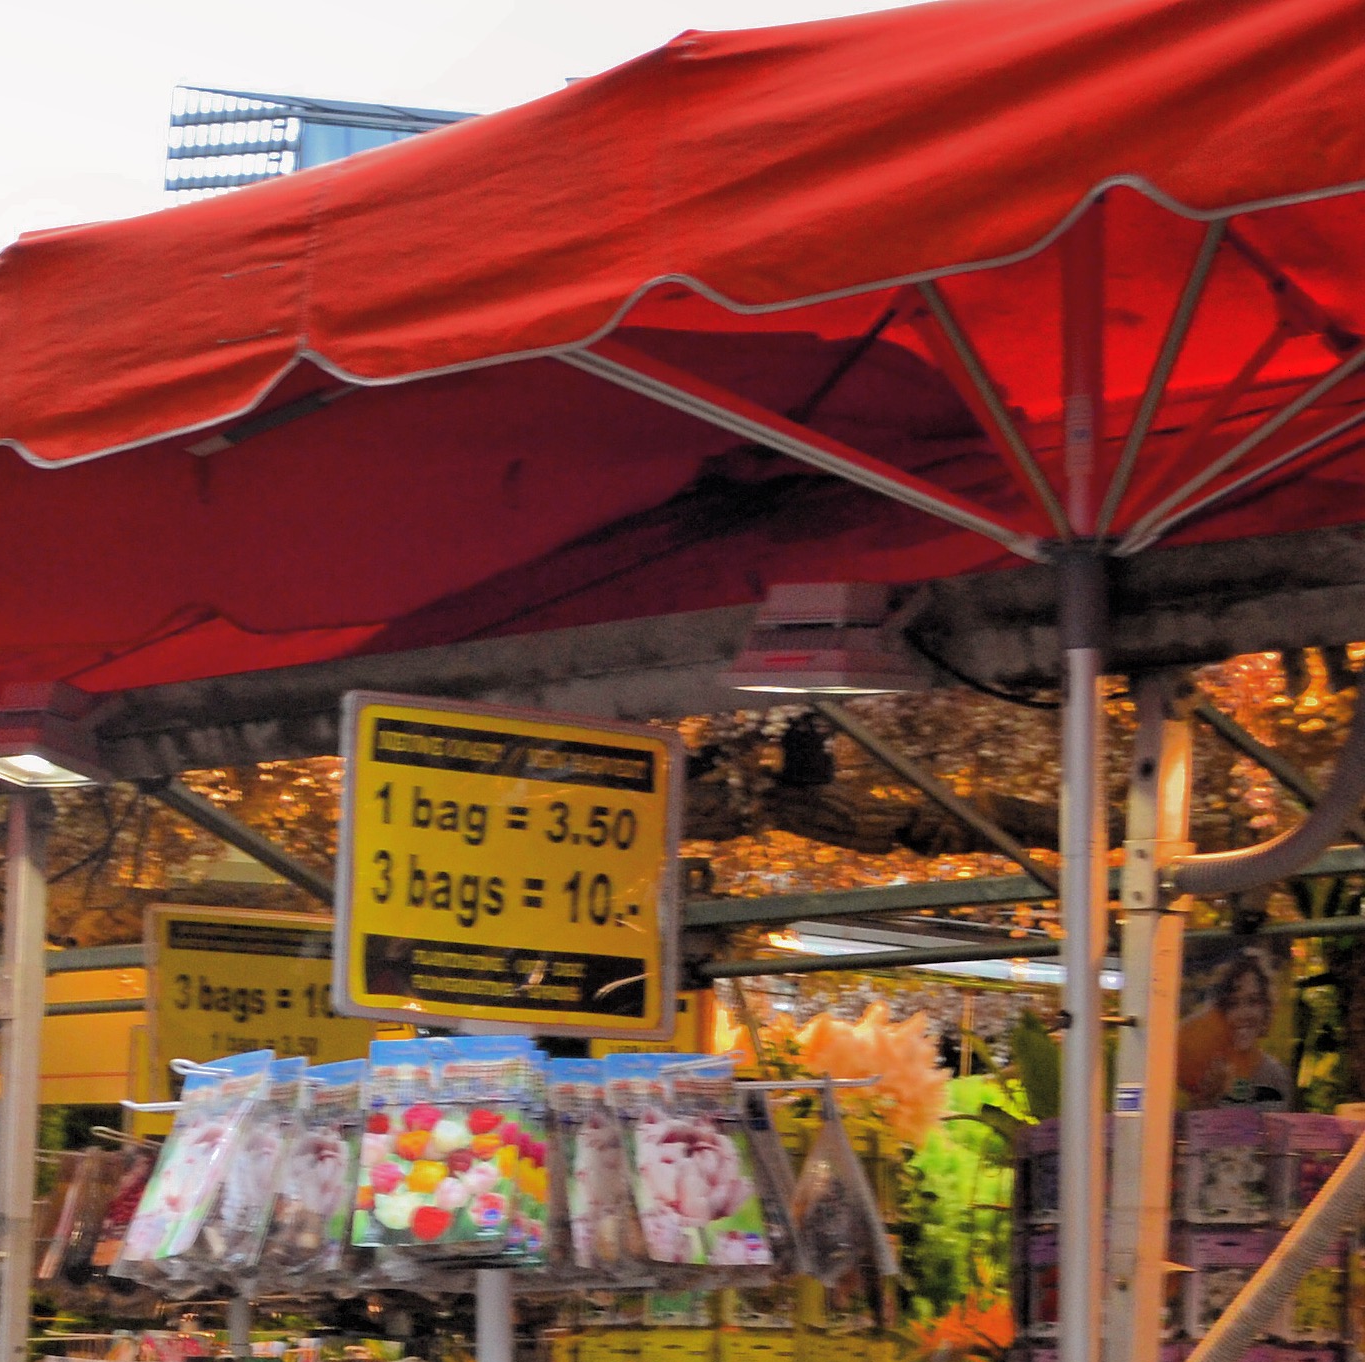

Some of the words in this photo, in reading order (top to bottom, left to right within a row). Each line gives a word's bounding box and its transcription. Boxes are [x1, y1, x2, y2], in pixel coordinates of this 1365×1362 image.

[375, 782, 393, 824] 1
[412, 786, 488, 845] bag
[506, 806, 528, 830] =
[546, 801, 636, 850] 3.50
[373, 850, 393, 904] 3
[408, 854, 505, 927] bags
[522, 878, 543, 908] =
[174, 973, 191, 1011] 3
[198, 975, 266, 1023] bags
[276, 987, 292, 1009] =
